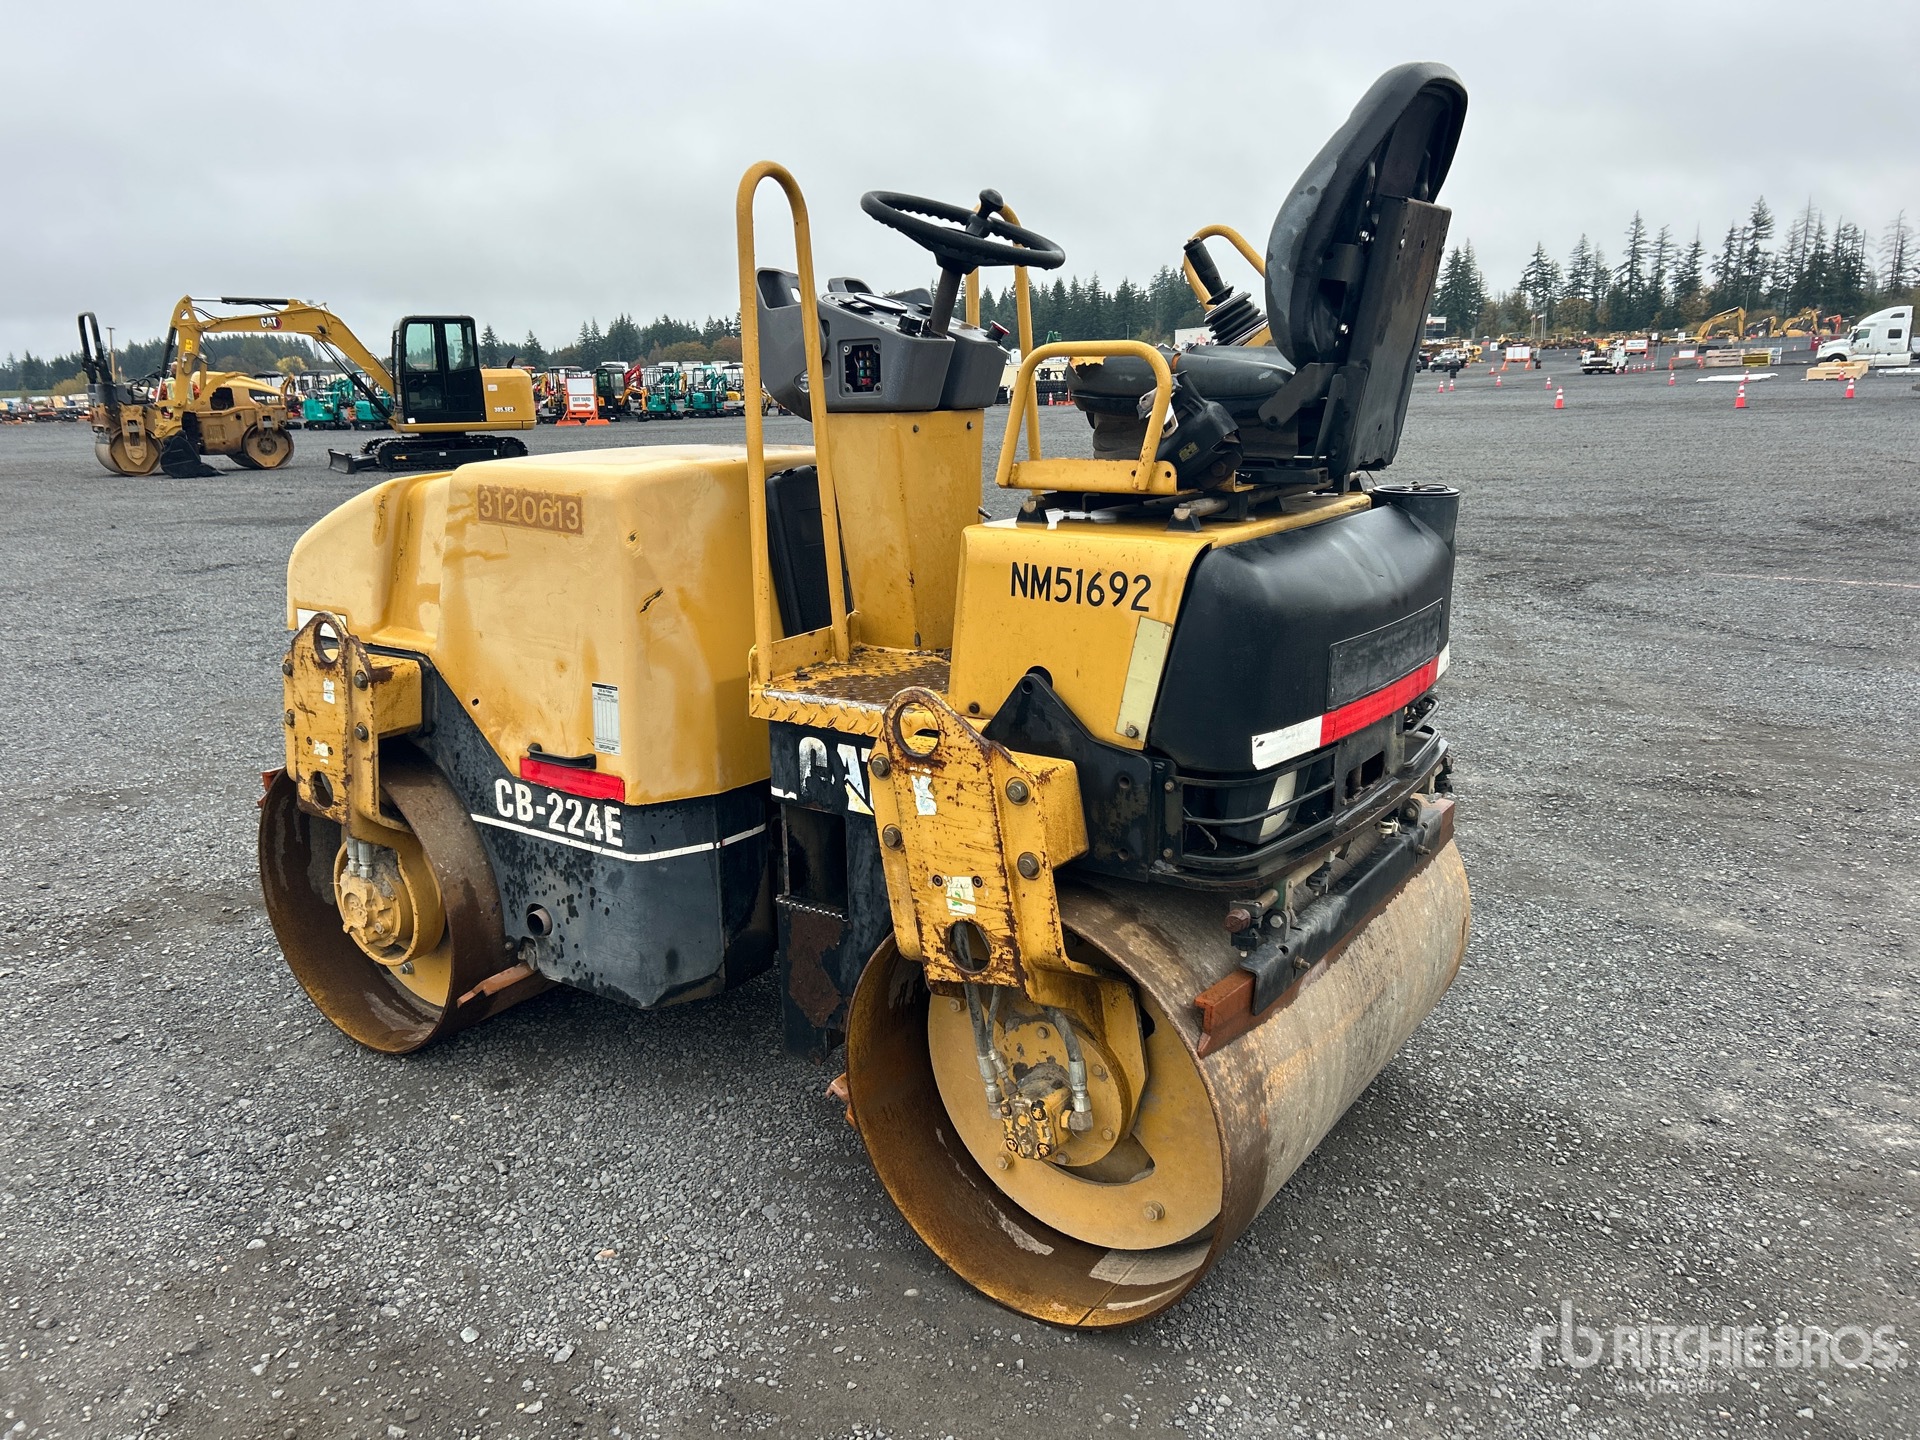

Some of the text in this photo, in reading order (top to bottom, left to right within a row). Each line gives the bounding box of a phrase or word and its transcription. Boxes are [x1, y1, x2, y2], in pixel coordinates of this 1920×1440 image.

[260, 316, 278, 328] CAT
[266, 395, 280, 404] CAT
[479, 490, 580, 531] 3120613
[1011, 561, 1152, 612] NM51692
[495, 778, 624, 848] CB-224E
